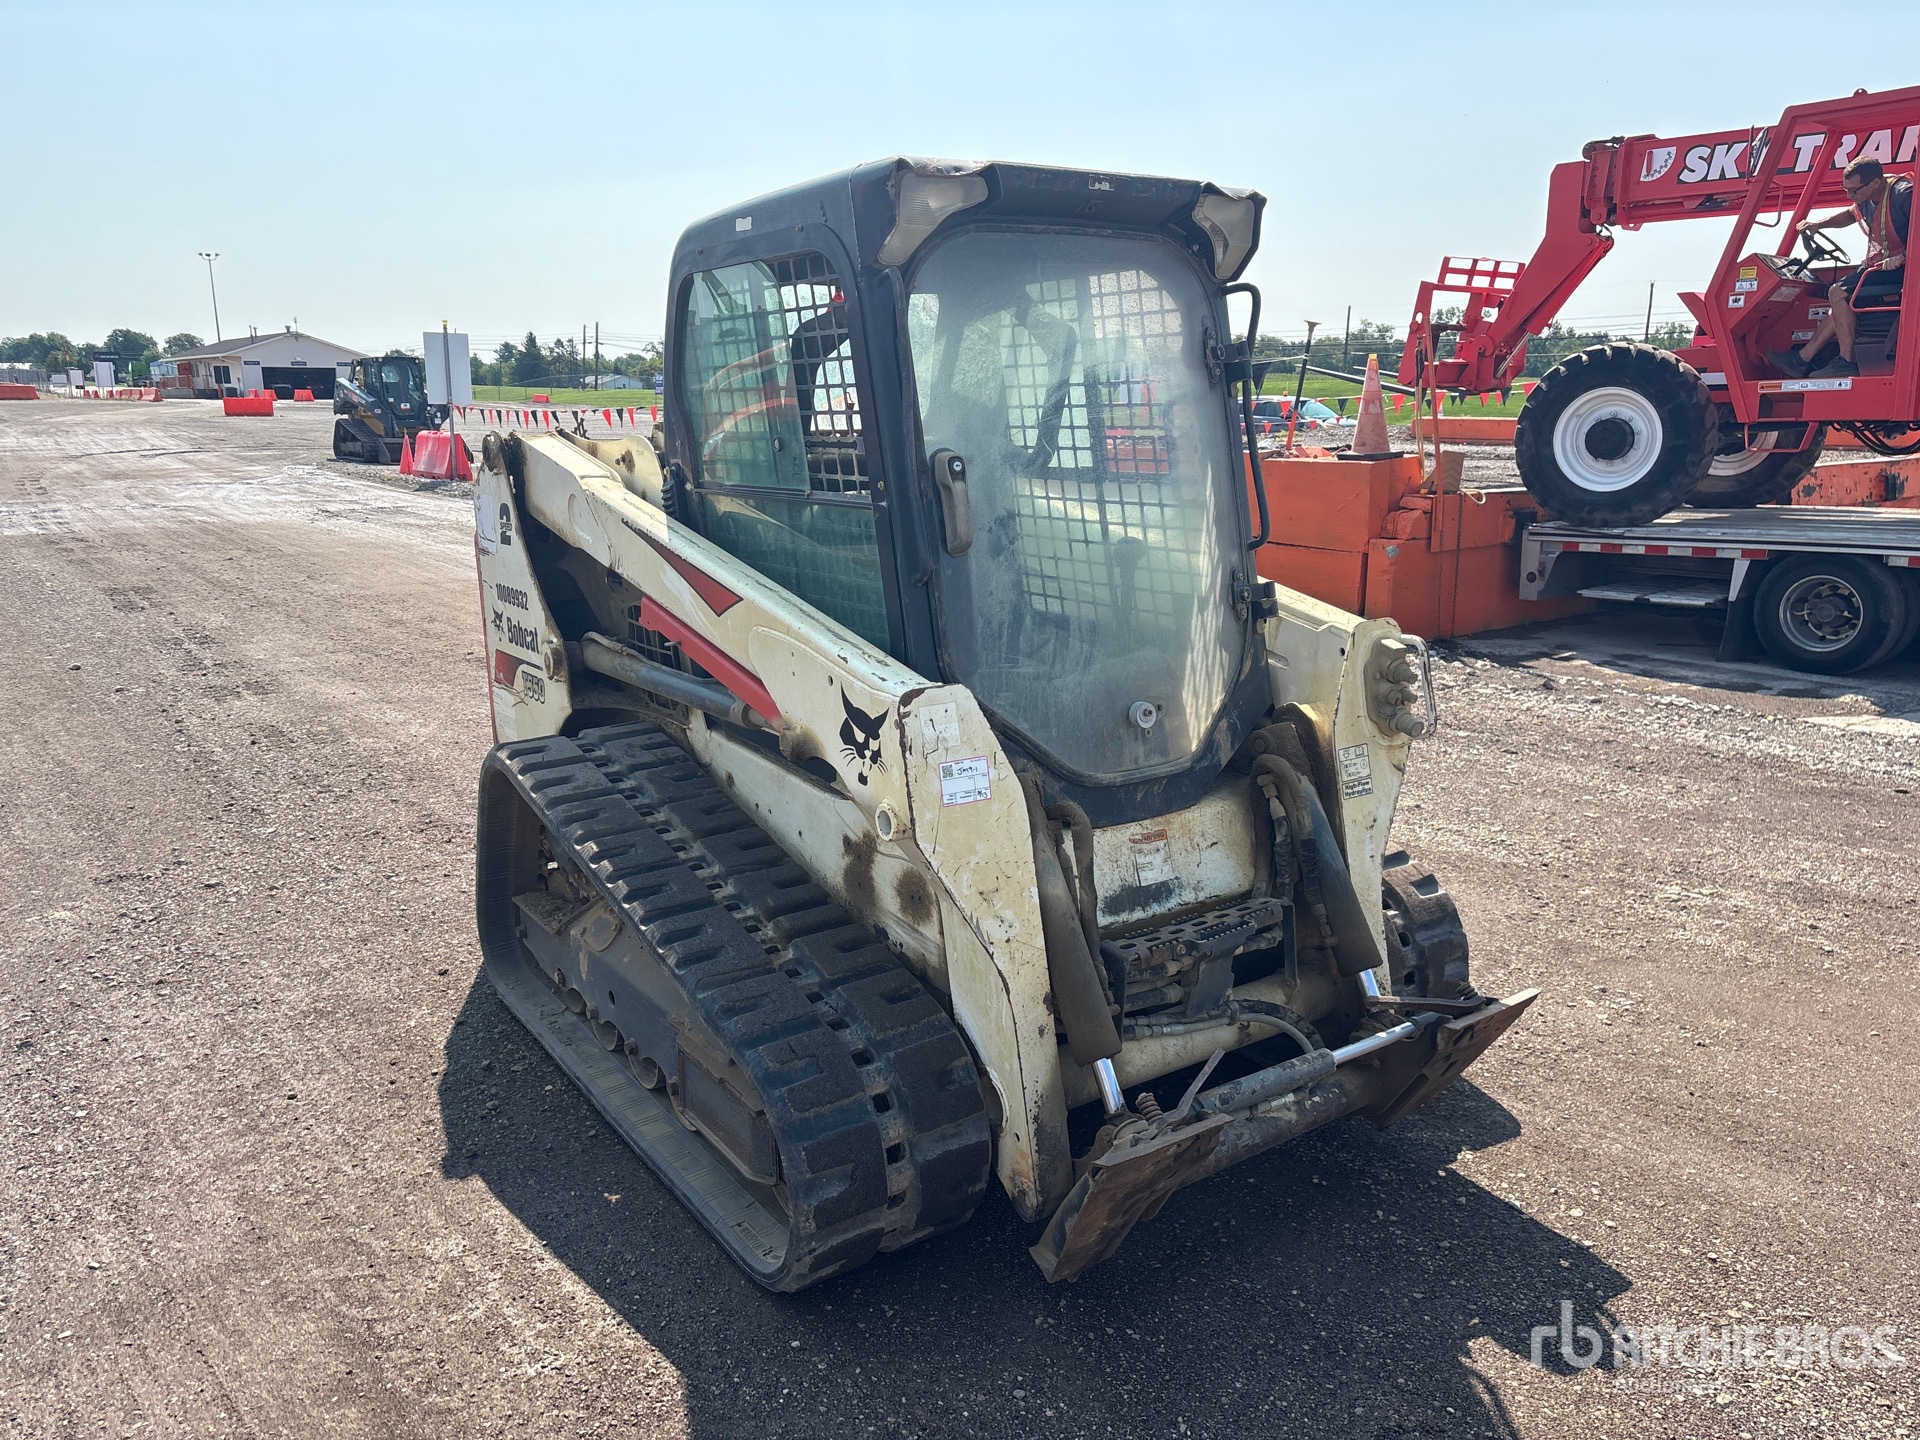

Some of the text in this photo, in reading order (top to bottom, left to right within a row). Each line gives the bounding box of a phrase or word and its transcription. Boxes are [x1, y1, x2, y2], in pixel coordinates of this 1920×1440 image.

[500, 521, 512, 531] SPEED
[495, 582, 529, 611] 10089932
[506, 616, 540, 654] Bobcat
